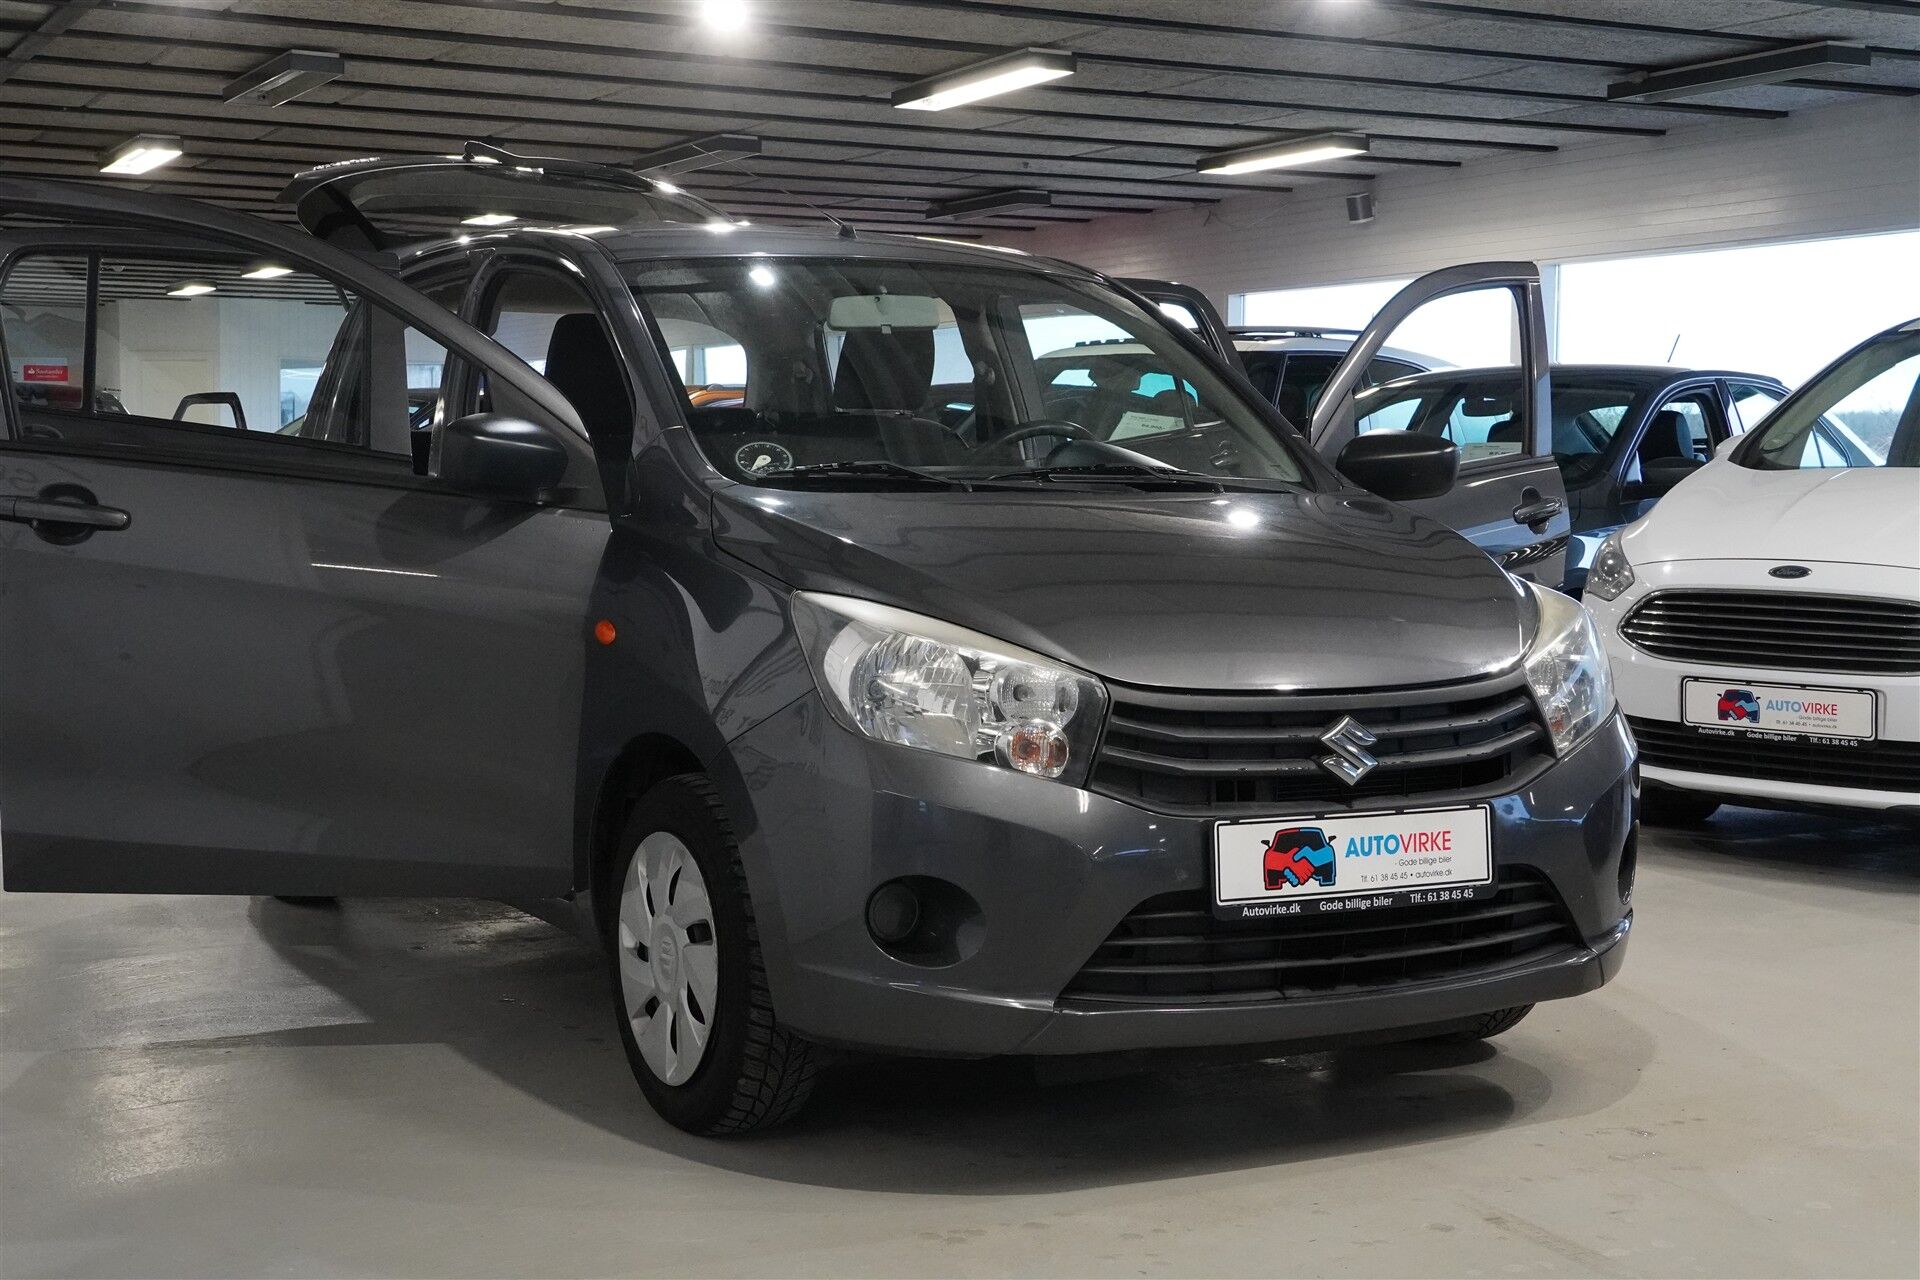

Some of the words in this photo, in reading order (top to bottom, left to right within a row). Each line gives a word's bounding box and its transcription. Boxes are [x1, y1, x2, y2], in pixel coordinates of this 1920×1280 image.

[1766, 699, 1838, 716] AUTOVIRKE
[1698, 727, 1735, 736] Autovirke.dk
[1746, 731, 1762, 739] Gode
[1764, 732, 1781, 741] billige
[1783, 734, 1797, 742] biler
[1840, 738, 1848, 746] 45
[1849, 739, 1858, 747] 45
[1345, 831, 1452, 858] AUTOVIRKE
[1398, 858, 1418, 867] Gode
[1419, 856, 1437, 866] billige
[1438, 855, 1452, 864] biler
[1370, 874, 1378, 883] 61
[1381, 873, 1389, 882] 38
[1390, 872, 1399, 881] 45
[1400, 871, 1408, 880] 45
[1410, 892, 1426, 903] Tlf.:
[1427, 892, 1438, 902] 61
[1439, 891, 1450, 901] 38
[1451, 889, 1462, 900] 45
[1463, 888, 1474, 898] 45
[1242, 902, 1301, 917] Autovirke.dk
[1320, 900, 1344, 911] Gode
[1345, 898, 1372, 910] billige
[1373, 896, 1393, 907] biler
